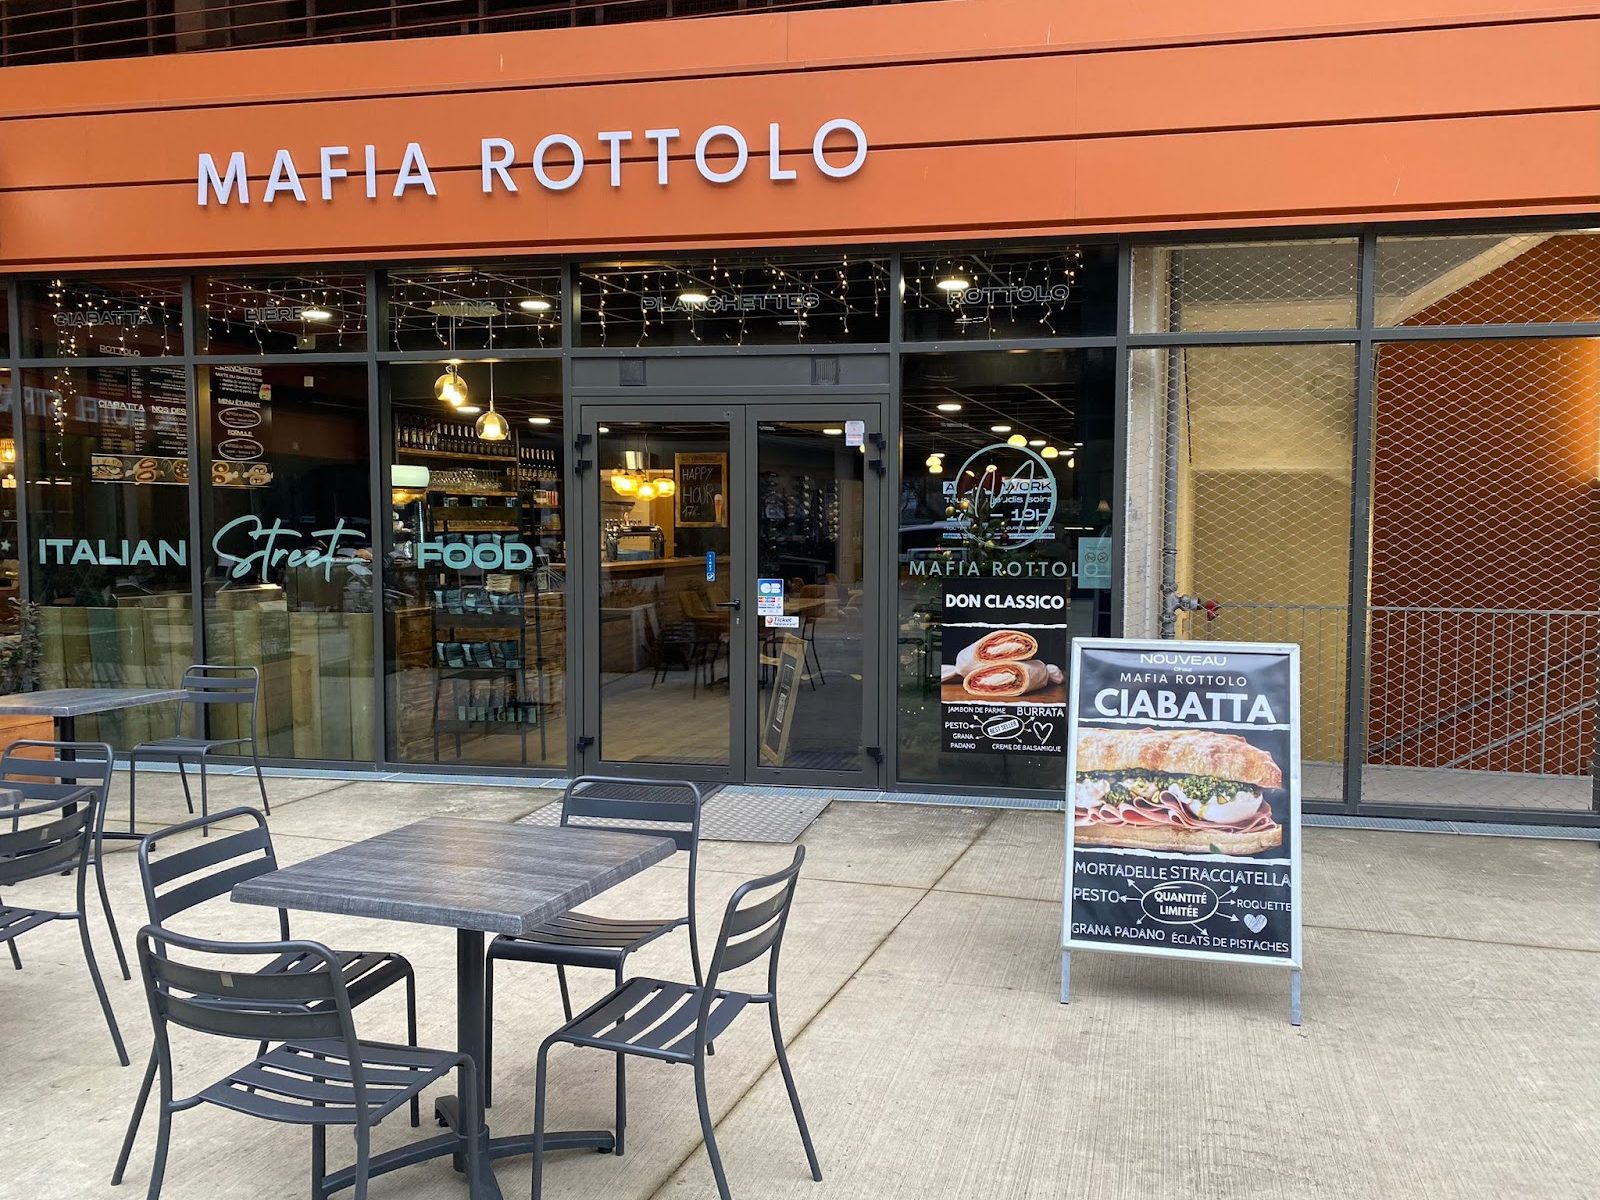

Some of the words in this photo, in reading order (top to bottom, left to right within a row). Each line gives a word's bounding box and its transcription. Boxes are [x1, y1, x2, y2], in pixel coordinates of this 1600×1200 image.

[197, 142, 438, 206] MAFIA
[481, 118, 868, 193] ROTTOLO
[640, 293, 820, 312] PLANCHETTES
[948, 284, 1069, 306] ROTTOLO
[54, 309, 153, 327] CIABATTA
[99, 344, 140, 357] ROTTOLO
[98, 400, 145, 412] CIABATTA
[217, 397, 235, 405] MENU
[152, 405, 169, 414] NOS
[682, 467, 714, 481] HAPPY
[682, 483, 714, 505] HOUR
[945, 481, 1052, 492] AWORK
[39, 538, 187, 567] ITALIAN
[211, 514, 371, 583] Street
[417, 543, 533, 570] FOOD
[909, 561, 980, 576] MAFIA
[992, 561, 1099, 578] ROTTOLO
[760, 582, 781, 594] CB
[945, 593, 981, 608] DON
[984, 594, 1065, 610] CLASSICO
[1140, 653, 1227, 666] NOUVEAU
[1120, 672, 1168, 684] MAFIA
[1176, 674, 1247, 687] ROTTOLO
[1016, 706, 1064, 717] BURRATA
[1094, 687, 1277, 724] CIABATTA
[945, 721, 970, 730] PESTO
[989, 726, 1001, 735] BEST
[1001, 720, 1018, 731] SELLER
[950, 742, 976, 750] PADANO
[1022, 744, 1061, 752] BALSAMIQUE
[1075, 861, 1168, 881] MORTADELLE
[1170, 866, 1291, 888] STRACCIATELLA
[1073, 888, 1120, 903] PESTO
[1153, 890, 1207, 905] QUANTITÉ
[1159, 904, 1199, 918] LIMITÉE
[1236, 899, 1292, 912] ROQUETTE
[1071, 923, 1111, 937] GRANA
[1114, 926, 1166, 941] PADANO
[1171, 930, 1210, 946] ÉCLATS
[1212, 937, 1228, 948] DE
[1229, 937, 1289, 953] PISTACHES
